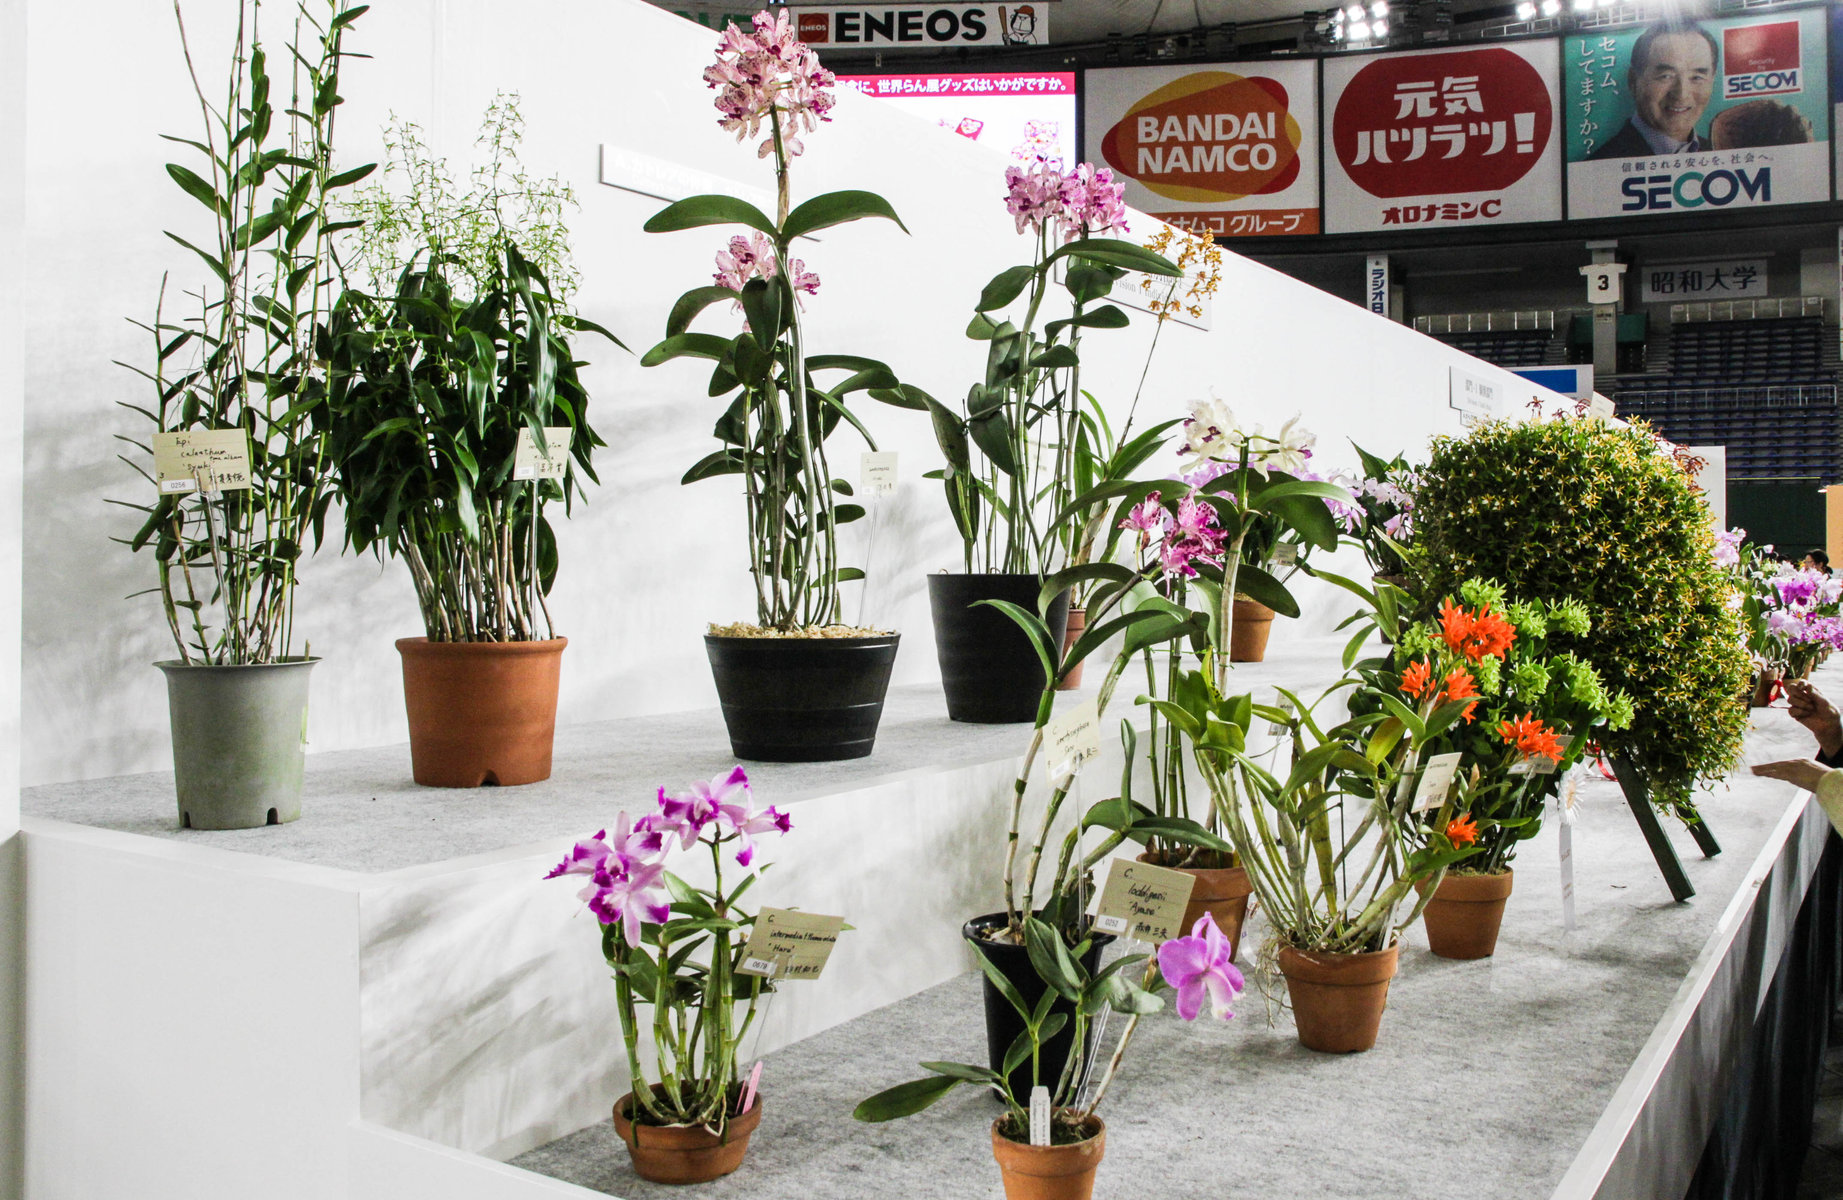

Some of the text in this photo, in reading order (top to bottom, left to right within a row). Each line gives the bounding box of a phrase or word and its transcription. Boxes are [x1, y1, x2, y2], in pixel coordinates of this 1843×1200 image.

[835, 9, 987, 43] ENEOS
[1393, 75, 1485, 120] 元気
[1728, 71, 1797, 93] SECOM
[1137, 112, 1276, 144] BANDAI
[1137, 143, 1277, 174] NAMCO
[1622, 167, 1771, 211] SECOM
[1382, 199, 1502, 225] オロナミンC
[1597, 274, 1609, 291] 3
[1651, 265, 1758, 294] 昭和大学
